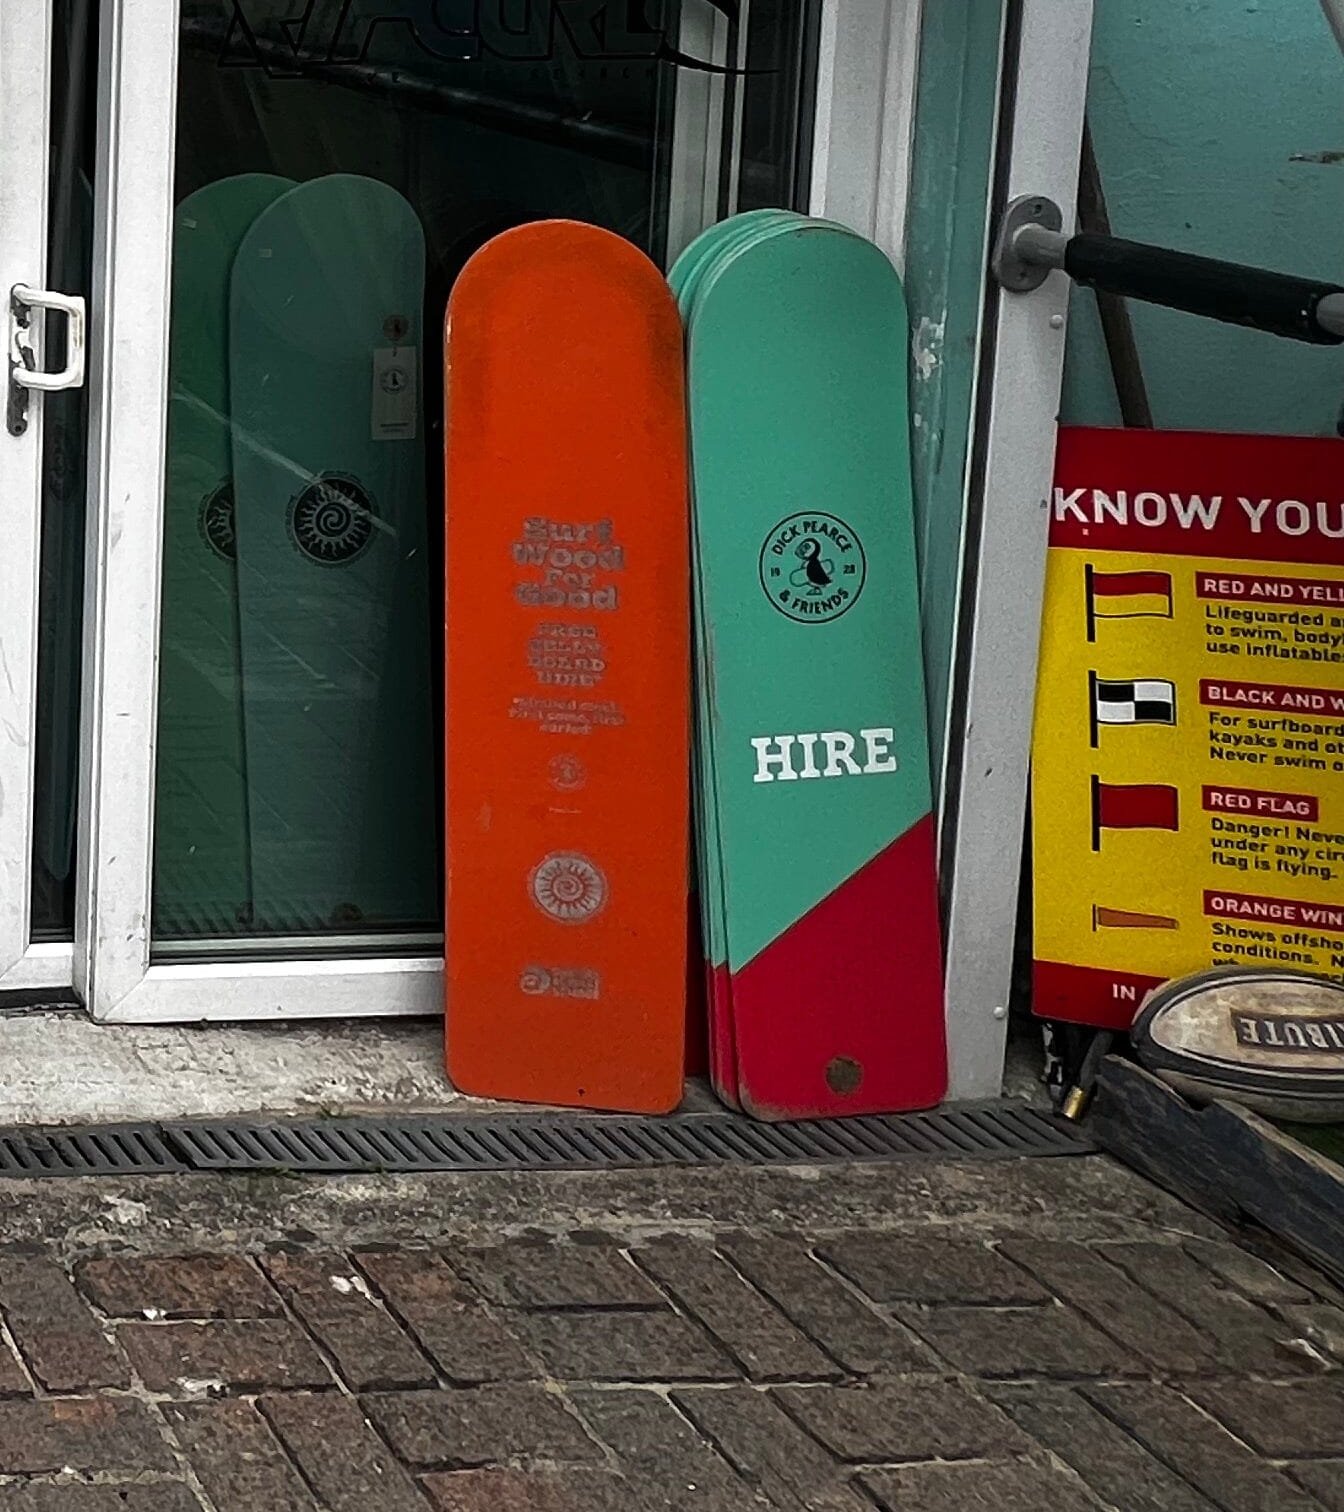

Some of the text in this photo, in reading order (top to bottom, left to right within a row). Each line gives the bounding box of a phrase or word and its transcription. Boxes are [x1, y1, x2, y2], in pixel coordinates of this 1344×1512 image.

[1054, 486, 1344, 539] KNOW YOU
[524, 517, 613, 544] Surf
[771, 520, 853, 555] DICK PEARCE
[512, 542, 624, 570] Wood
[515, 582, 618, 610] Good
[779, 587, 849, 614] & FRIENDS
[1204, 578, 1245, 595] RED
[1250, 582, 1294, 598] AND
[1206, 604, 1324, 626] Lifeguarded
[1206, 624, 1224, 636] to
[1293, 628, 1344, 648] body
[1207, 642, 1344, 664] use inflatable
[1207, 685, 1276, 706] BLACK
[1280, 692, 1325, 709] AND
[1208, 711, 1242, 727] For
[1209, 729, 1278, 749] kayaks
[1283, 737, 1319, 752] and
[750, 727, 898, 783] HIRE
[1210, 746, 1268, 764] Never
[1274, 755, 1327, 771] swim
[1210, 791, 1311, 816] RED FLAG
[1211, 817, 1290, 839] Danger!
[1211, 837, 1270, 853] under
[1275, 844, 1310, 861] any
[1212, 851, 1339, 882] flag is flying.
[1211, 896, 1297, 921] ORANGE
[1211, 922, 1277, 943] Shows
[1212, 941, 1320, 966] conditions.
[1112, 982, 1136, 1001] IN
[1240, 1017, 1344, 1050] IBUTE
